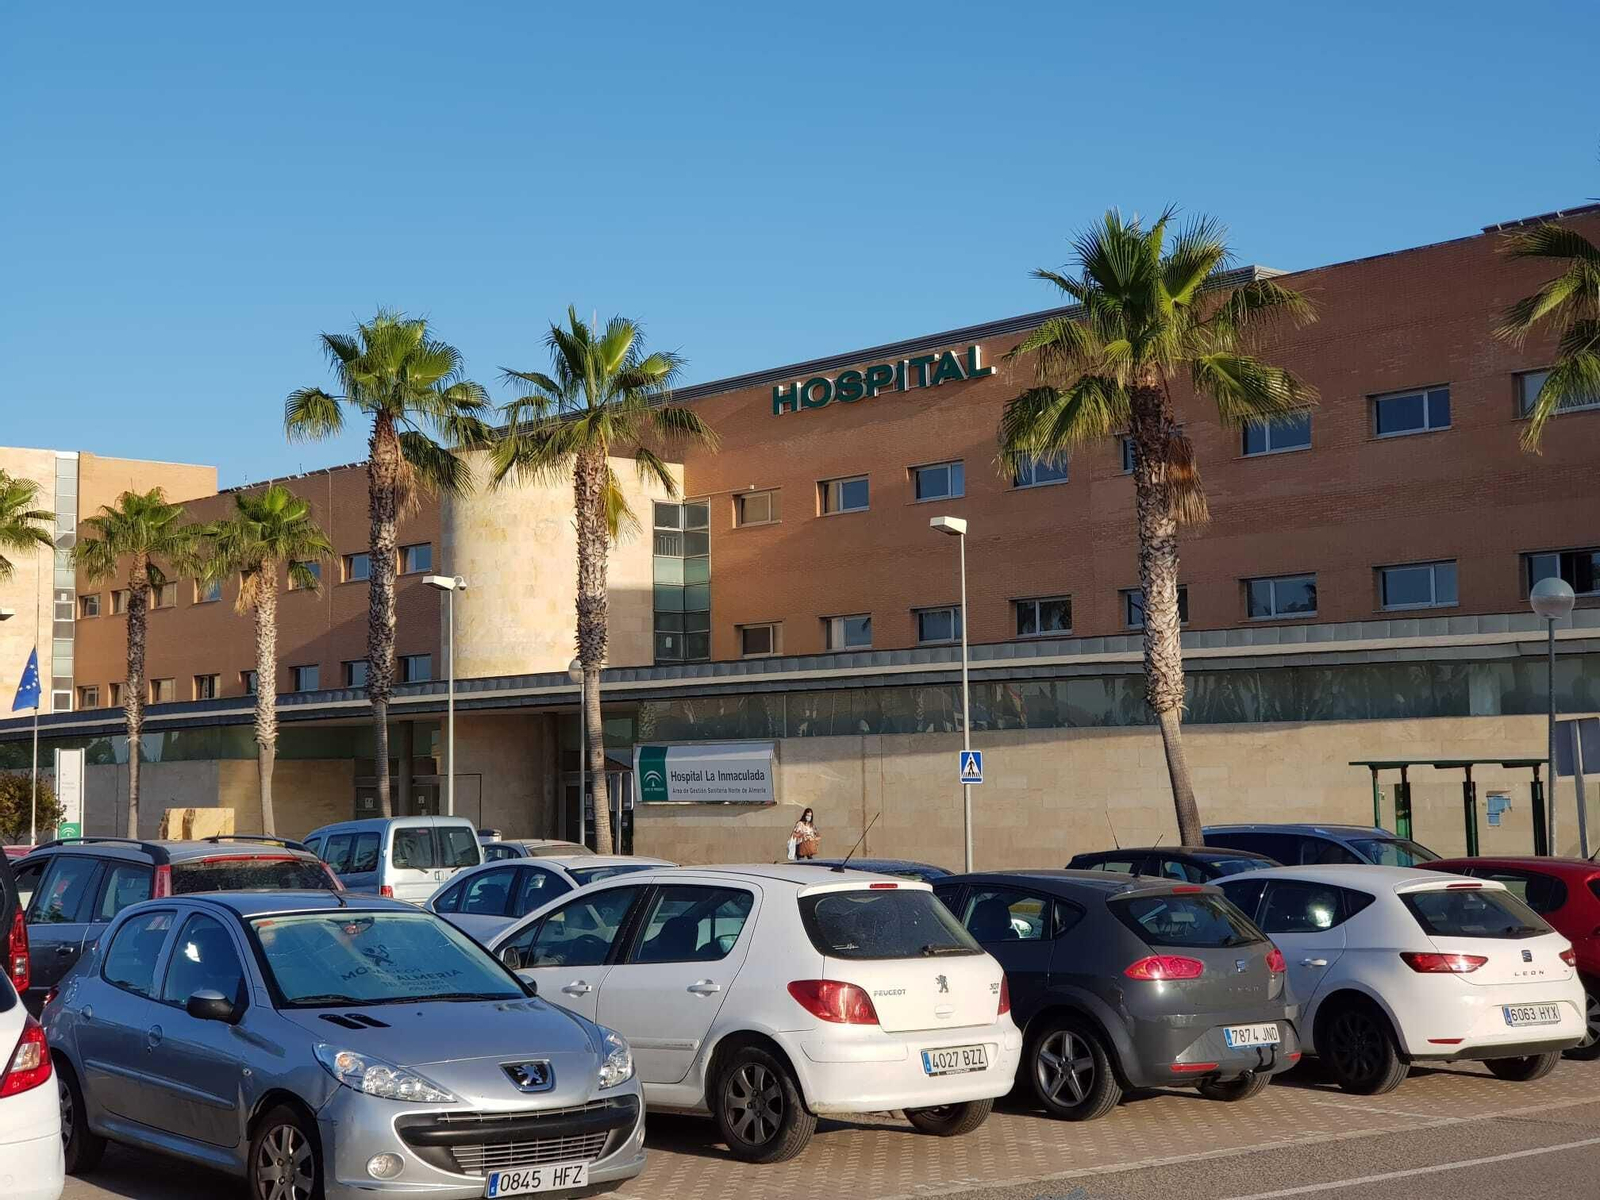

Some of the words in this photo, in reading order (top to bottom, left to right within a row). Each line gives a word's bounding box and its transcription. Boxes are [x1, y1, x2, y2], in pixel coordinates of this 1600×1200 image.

[772, 345, 997, 415] HOSPITAL
[670, 768, 703, 784] Hospital
[705, 770, 716, 781] La
[717, 769, 765, 781] Inmaculada
[873, 988, 907, 997] PEUGEOT
[1510, 1007, 1536, 1021] 6063
[1539, 1006, 1559, 1020] HYX
[1232, 1028, 1259, 1044] 7874
[932, 1051, 959, 1070] 4027
[962, 1048, 984, 1067] BZZ
[500, 1170, 542, 1192] 0845
[552, 1165, 583, 1187] HFZ
